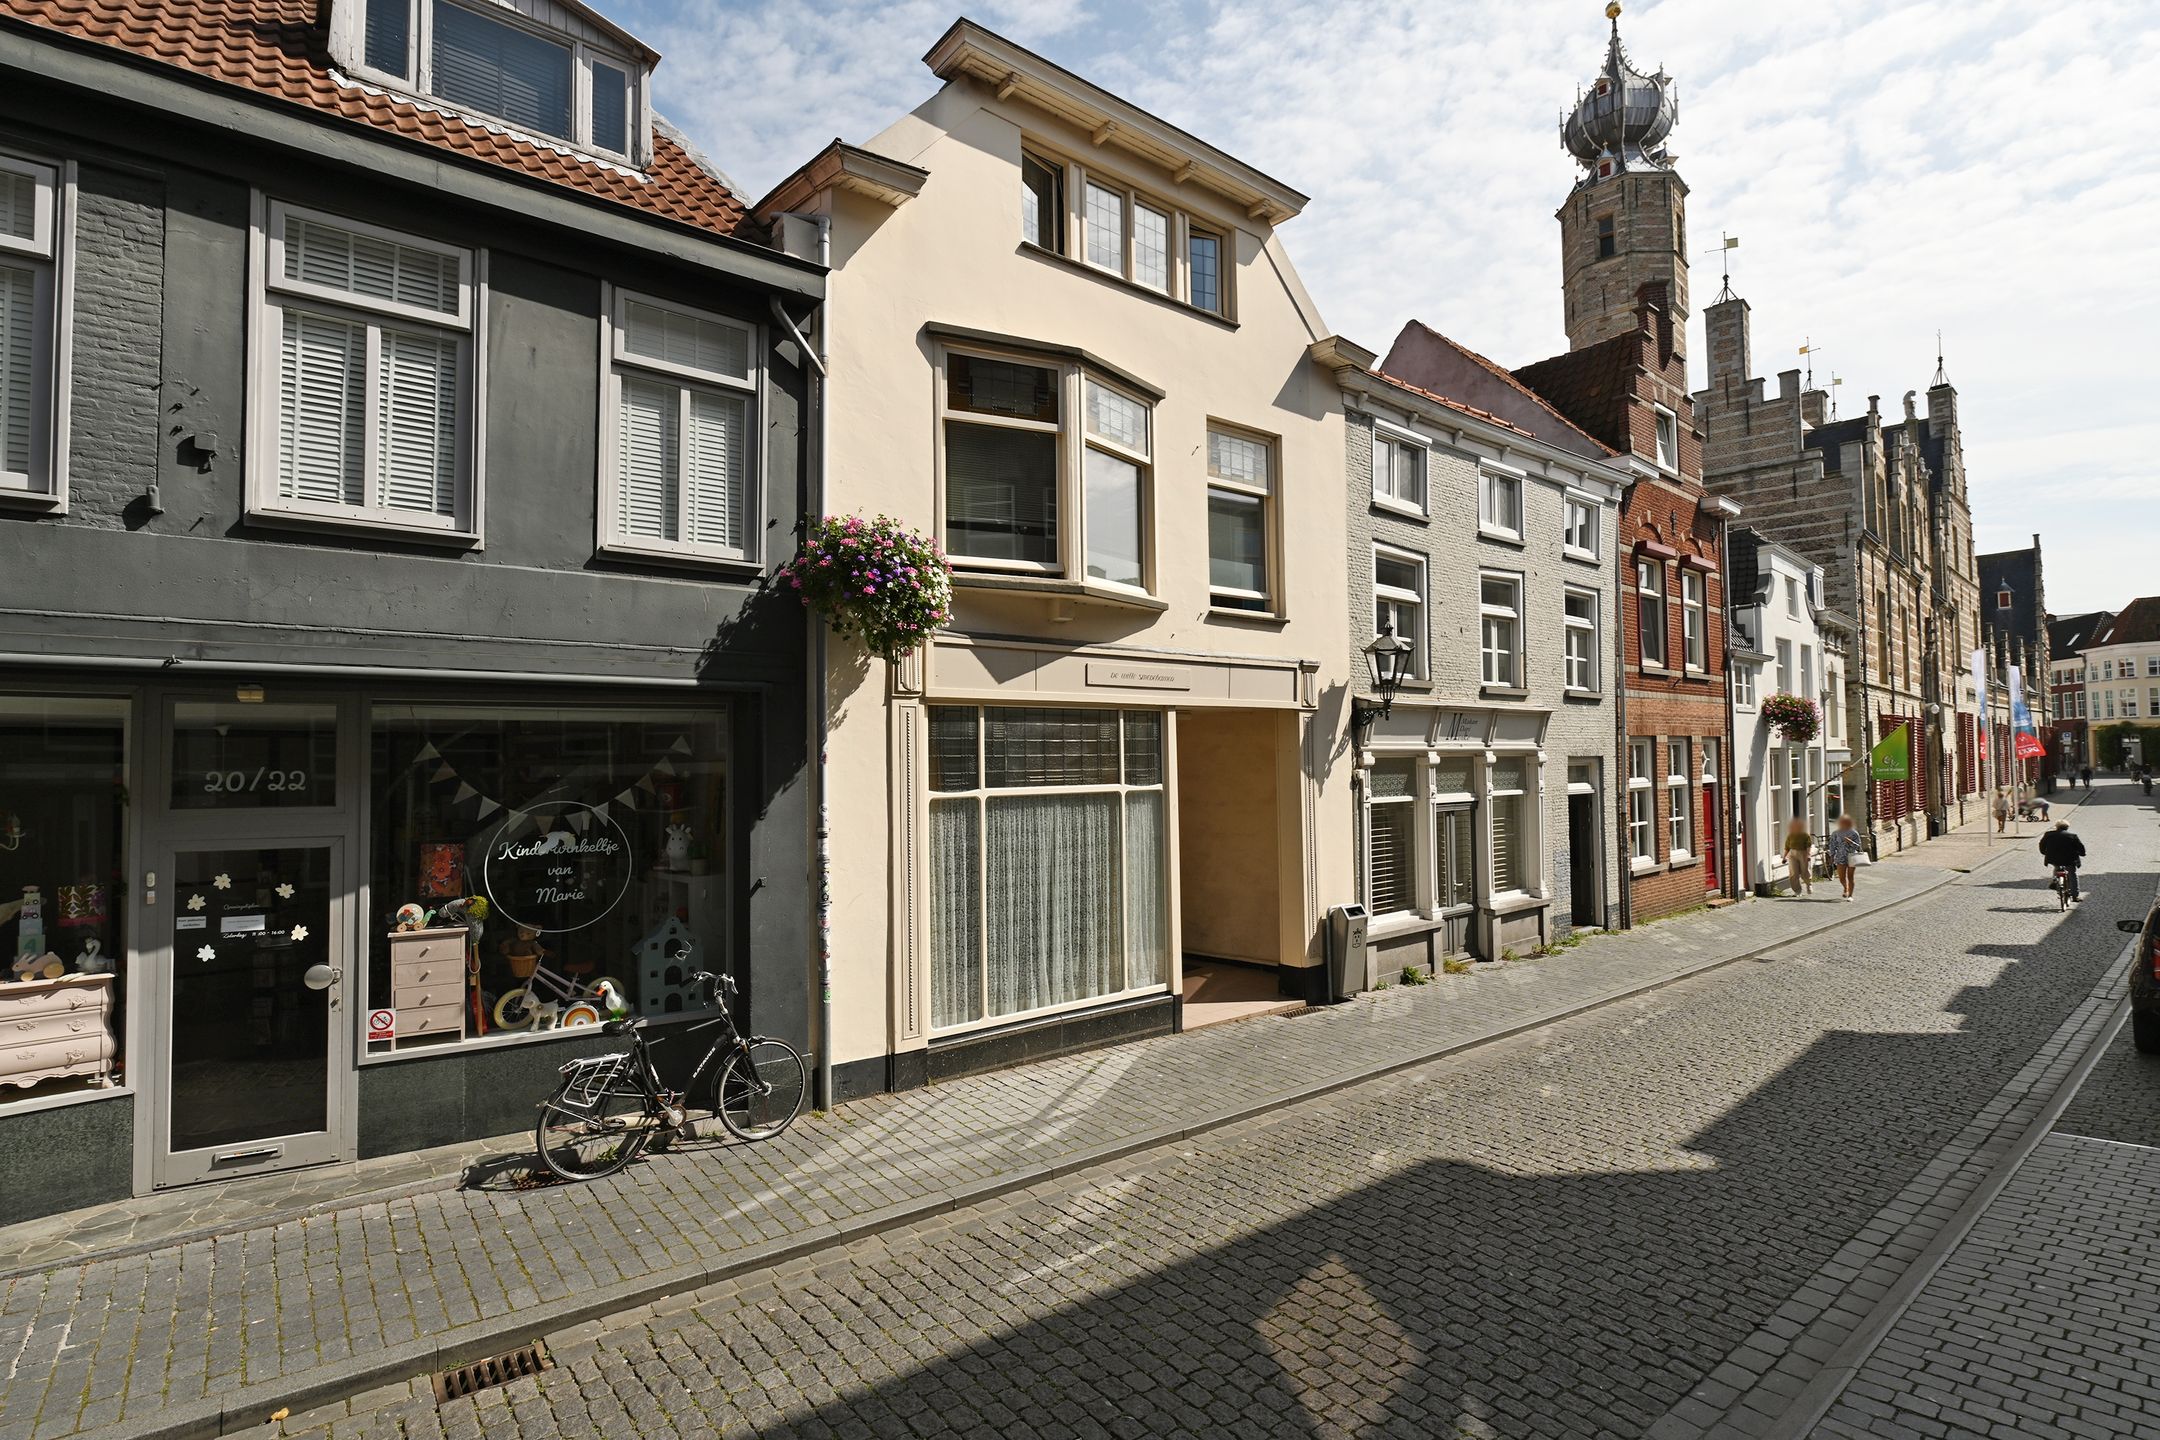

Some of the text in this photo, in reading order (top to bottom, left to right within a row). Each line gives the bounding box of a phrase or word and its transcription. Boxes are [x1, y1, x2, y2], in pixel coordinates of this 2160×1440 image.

[204, 767, 306, 792] 20/22
[547, 865, 574, 876] van
[536, 887, 585, 904] Marie
